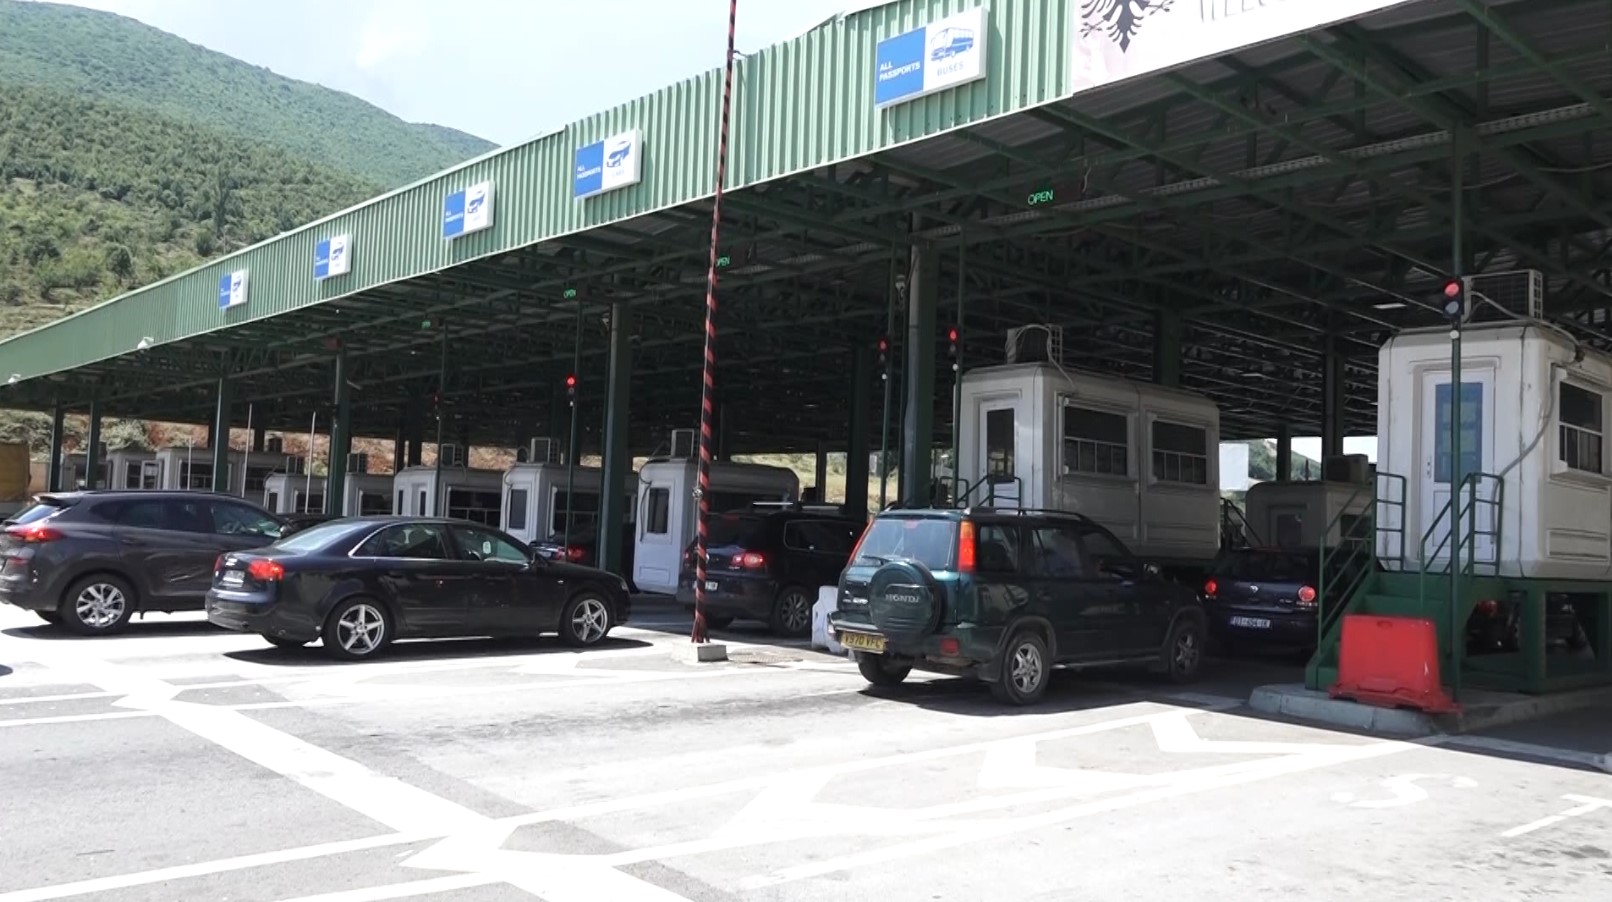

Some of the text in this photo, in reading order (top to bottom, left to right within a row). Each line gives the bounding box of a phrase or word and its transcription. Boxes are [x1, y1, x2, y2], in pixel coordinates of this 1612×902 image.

[879, 61, 921, 82] PASSPORTS
[880, 61, 893, 71] ALL
[937, 61, 964, 77] BUSES
[1027, 189, 1054, 206] OPEN
